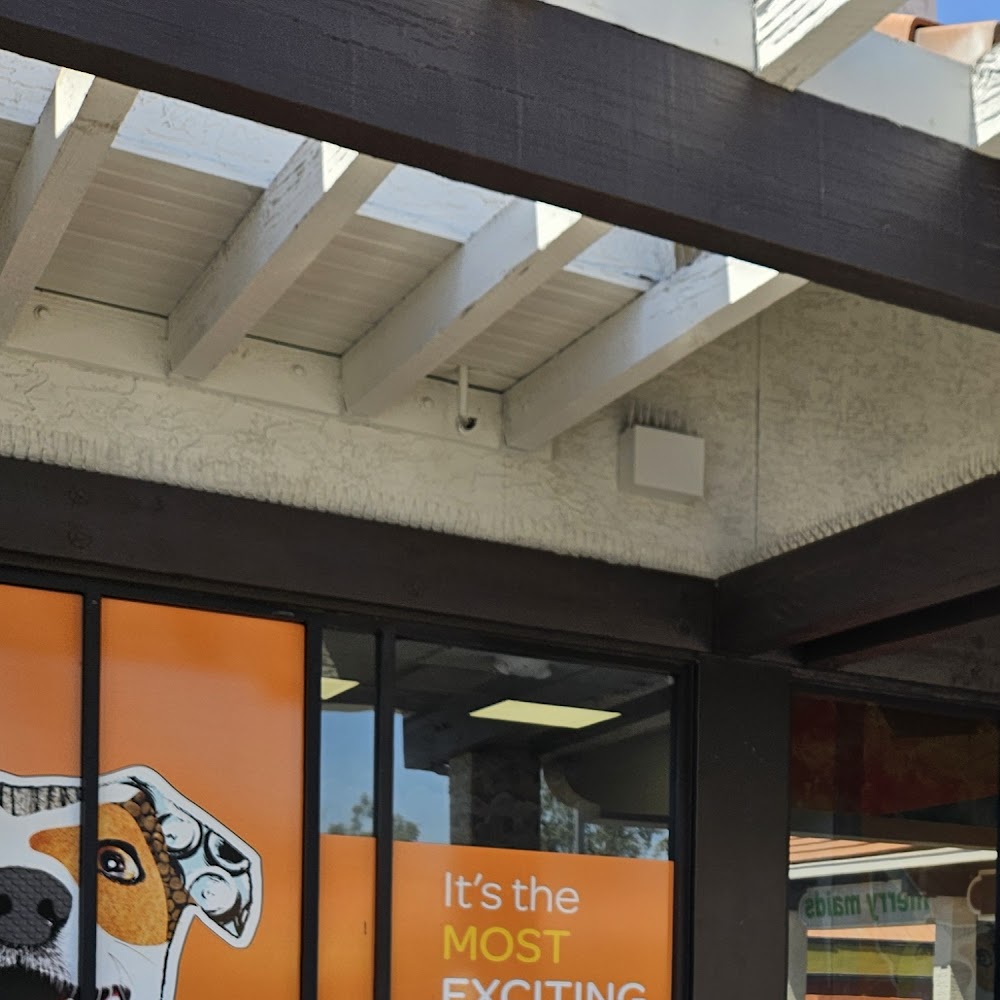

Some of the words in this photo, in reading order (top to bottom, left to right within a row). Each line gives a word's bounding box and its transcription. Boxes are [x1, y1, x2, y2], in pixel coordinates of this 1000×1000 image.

[443, 870, 503, 911] It's
[510, 874, 581, 914] the
[443, 923, 570, 964] MOST
